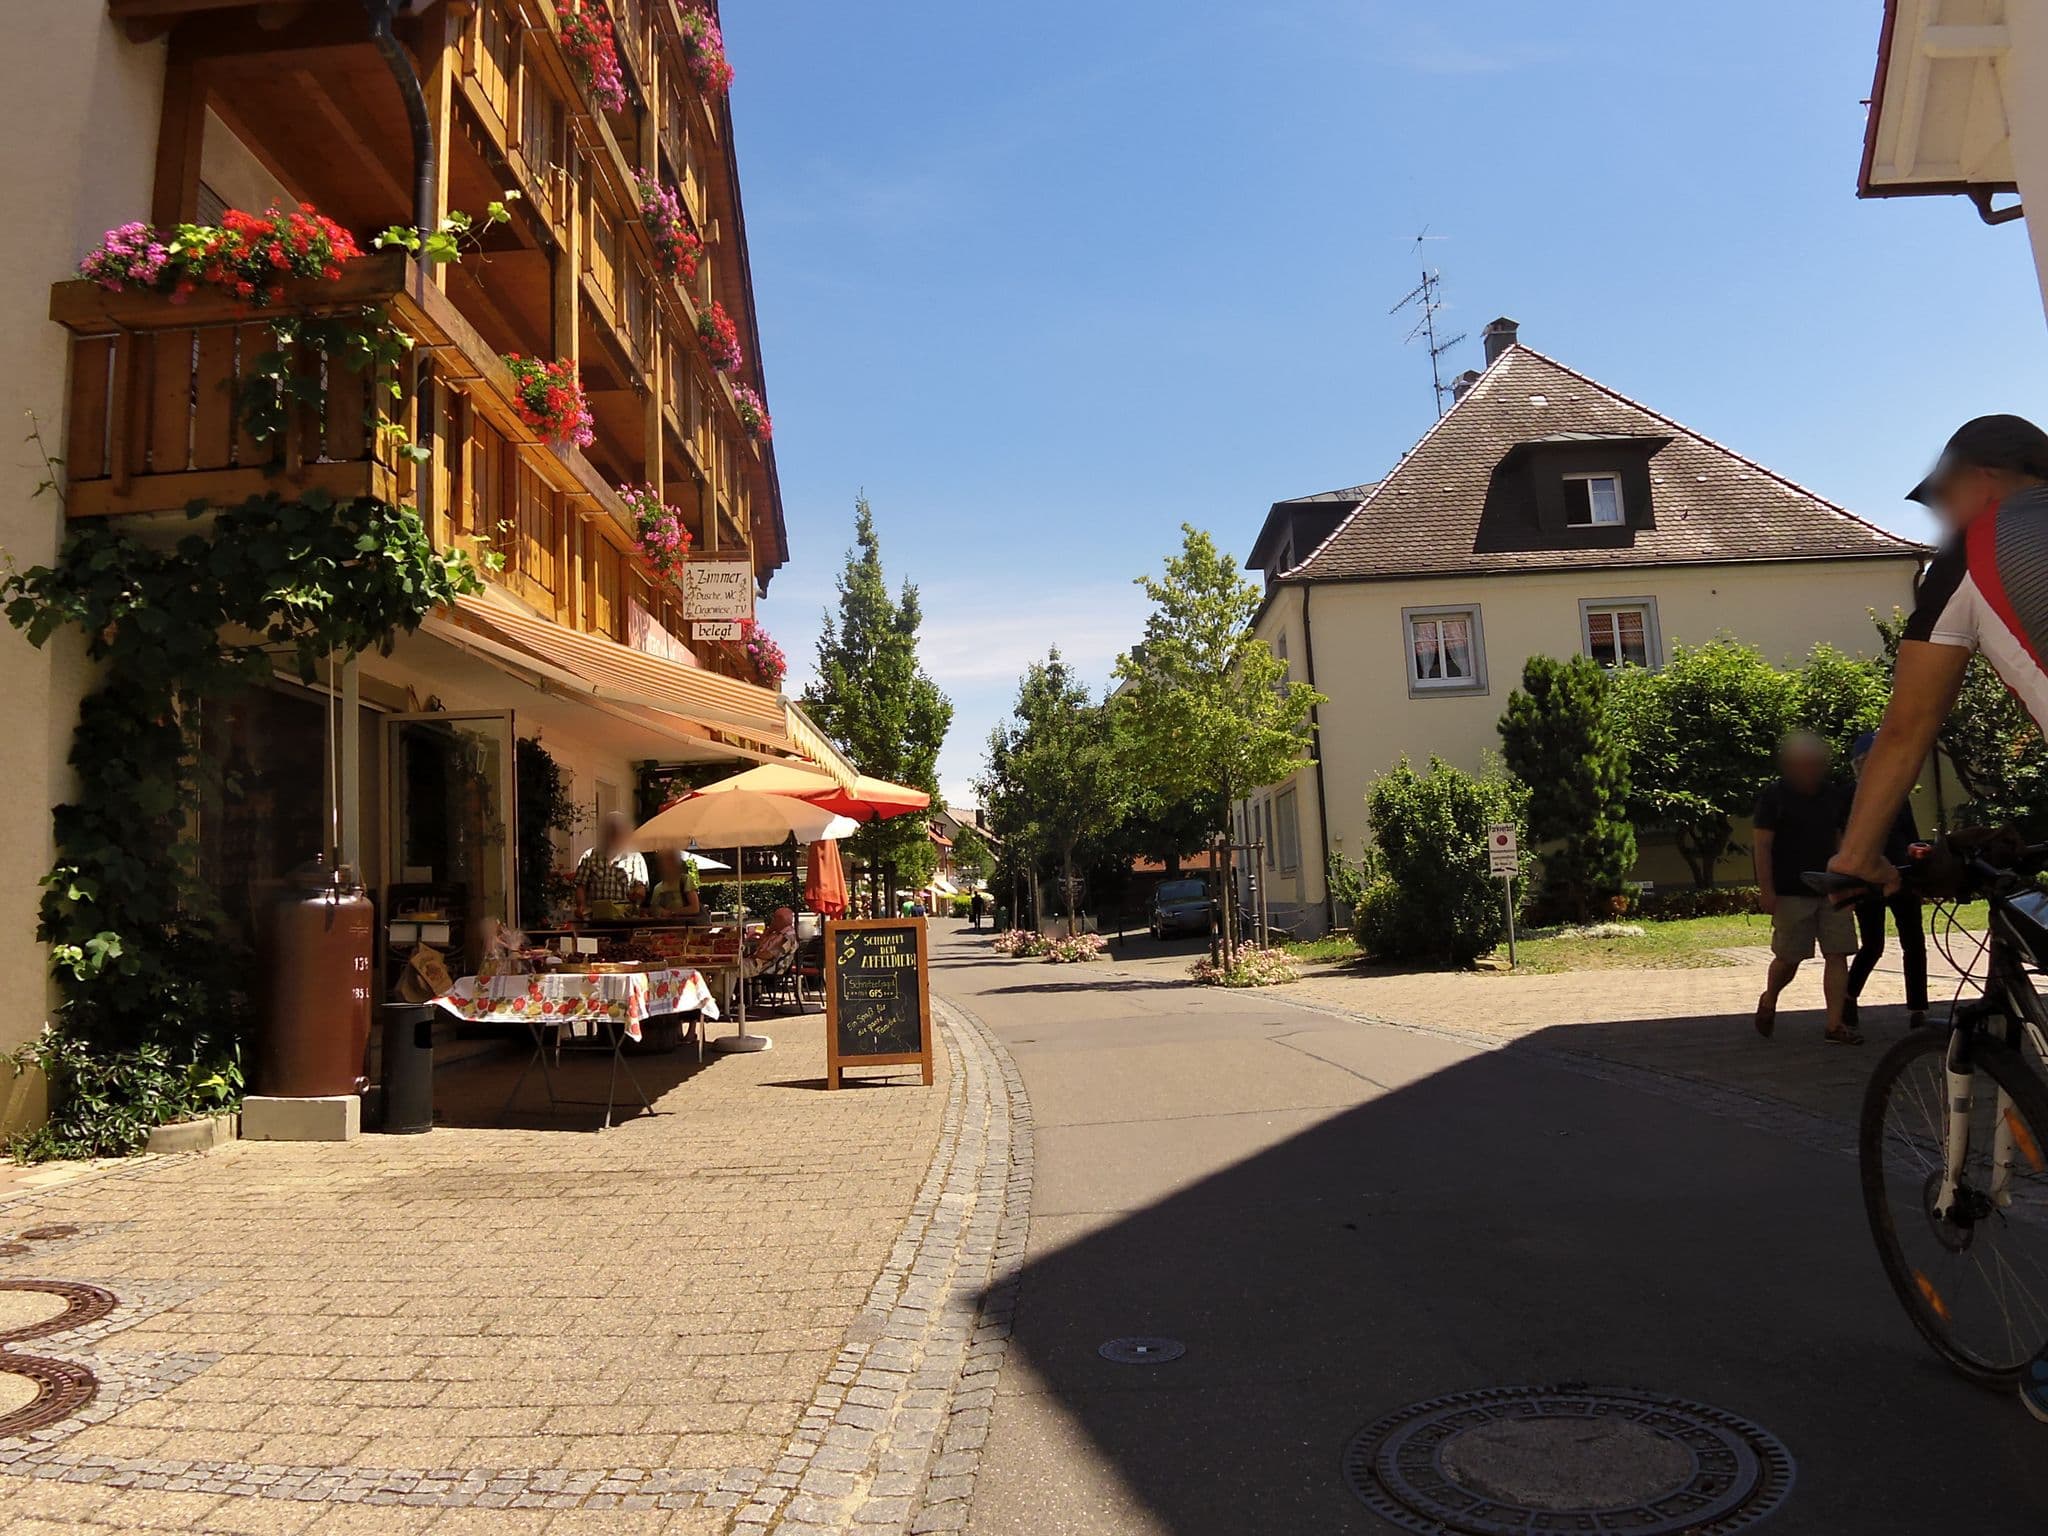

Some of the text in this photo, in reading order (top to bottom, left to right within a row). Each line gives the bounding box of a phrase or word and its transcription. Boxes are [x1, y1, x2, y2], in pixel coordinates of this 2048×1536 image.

[697, 570, 742, 584] Zimmer
[725, 590, 736, 600] WC
[735, 605, 747, 614] TV
[698, 624, 732, 640] belegt
[869, 989, 883, 998] GPS
